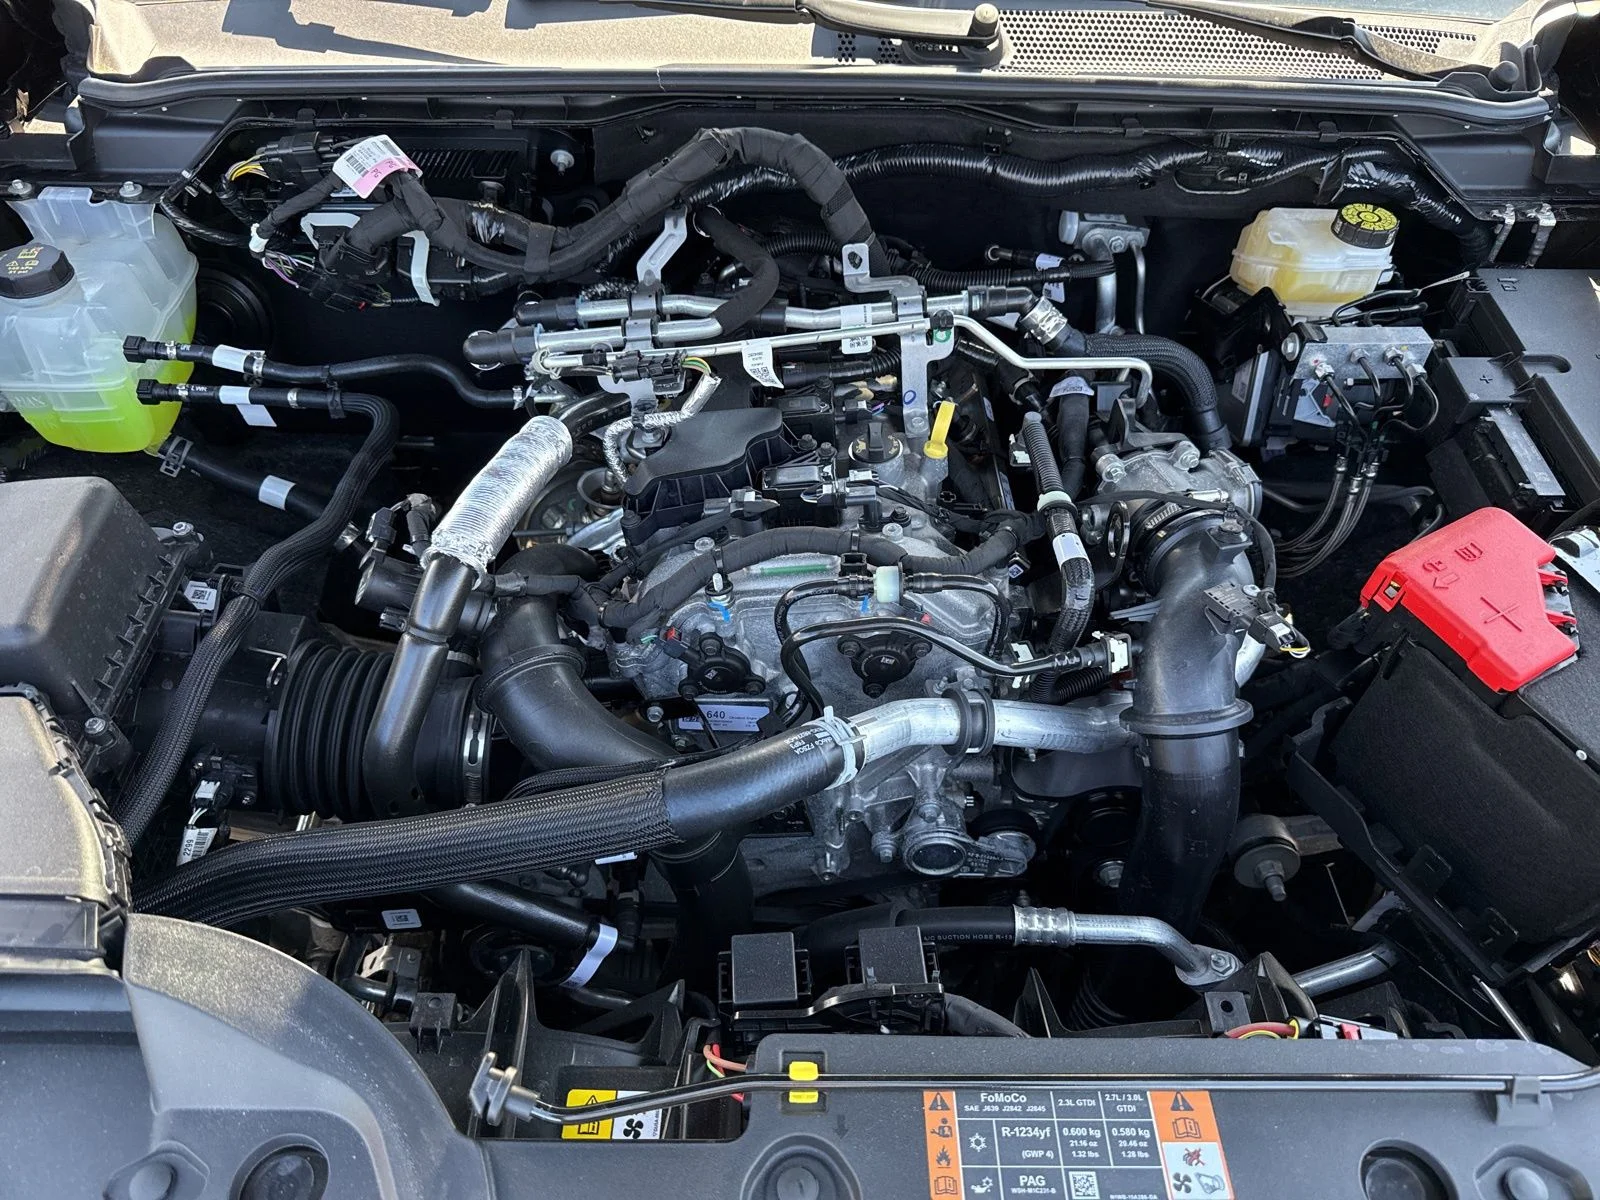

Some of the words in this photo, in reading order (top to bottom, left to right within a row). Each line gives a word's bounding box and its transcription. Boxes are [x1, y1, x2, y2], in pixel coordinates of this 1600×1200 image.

[706, 710, 726, 719] 640
[183, 839, 194, 856] 2299
[980, 1092, 1027, 1103] FoMoCo
[1001, 1127, 1051, 1140] R-1234yf
[1062, 1127, 1087, 1136] 0.600
[1088, 1127, 1101, 1138] kg
[1111, 1127, 1136, 1136] 0.580
[1138, 1127, 1151, 1138] kg
[1021, 1150, 1044, 1159] (GWP
[1045, 1150, 1054, 1159] 4)
[1019, 1175, 1046, 1187] PAG
